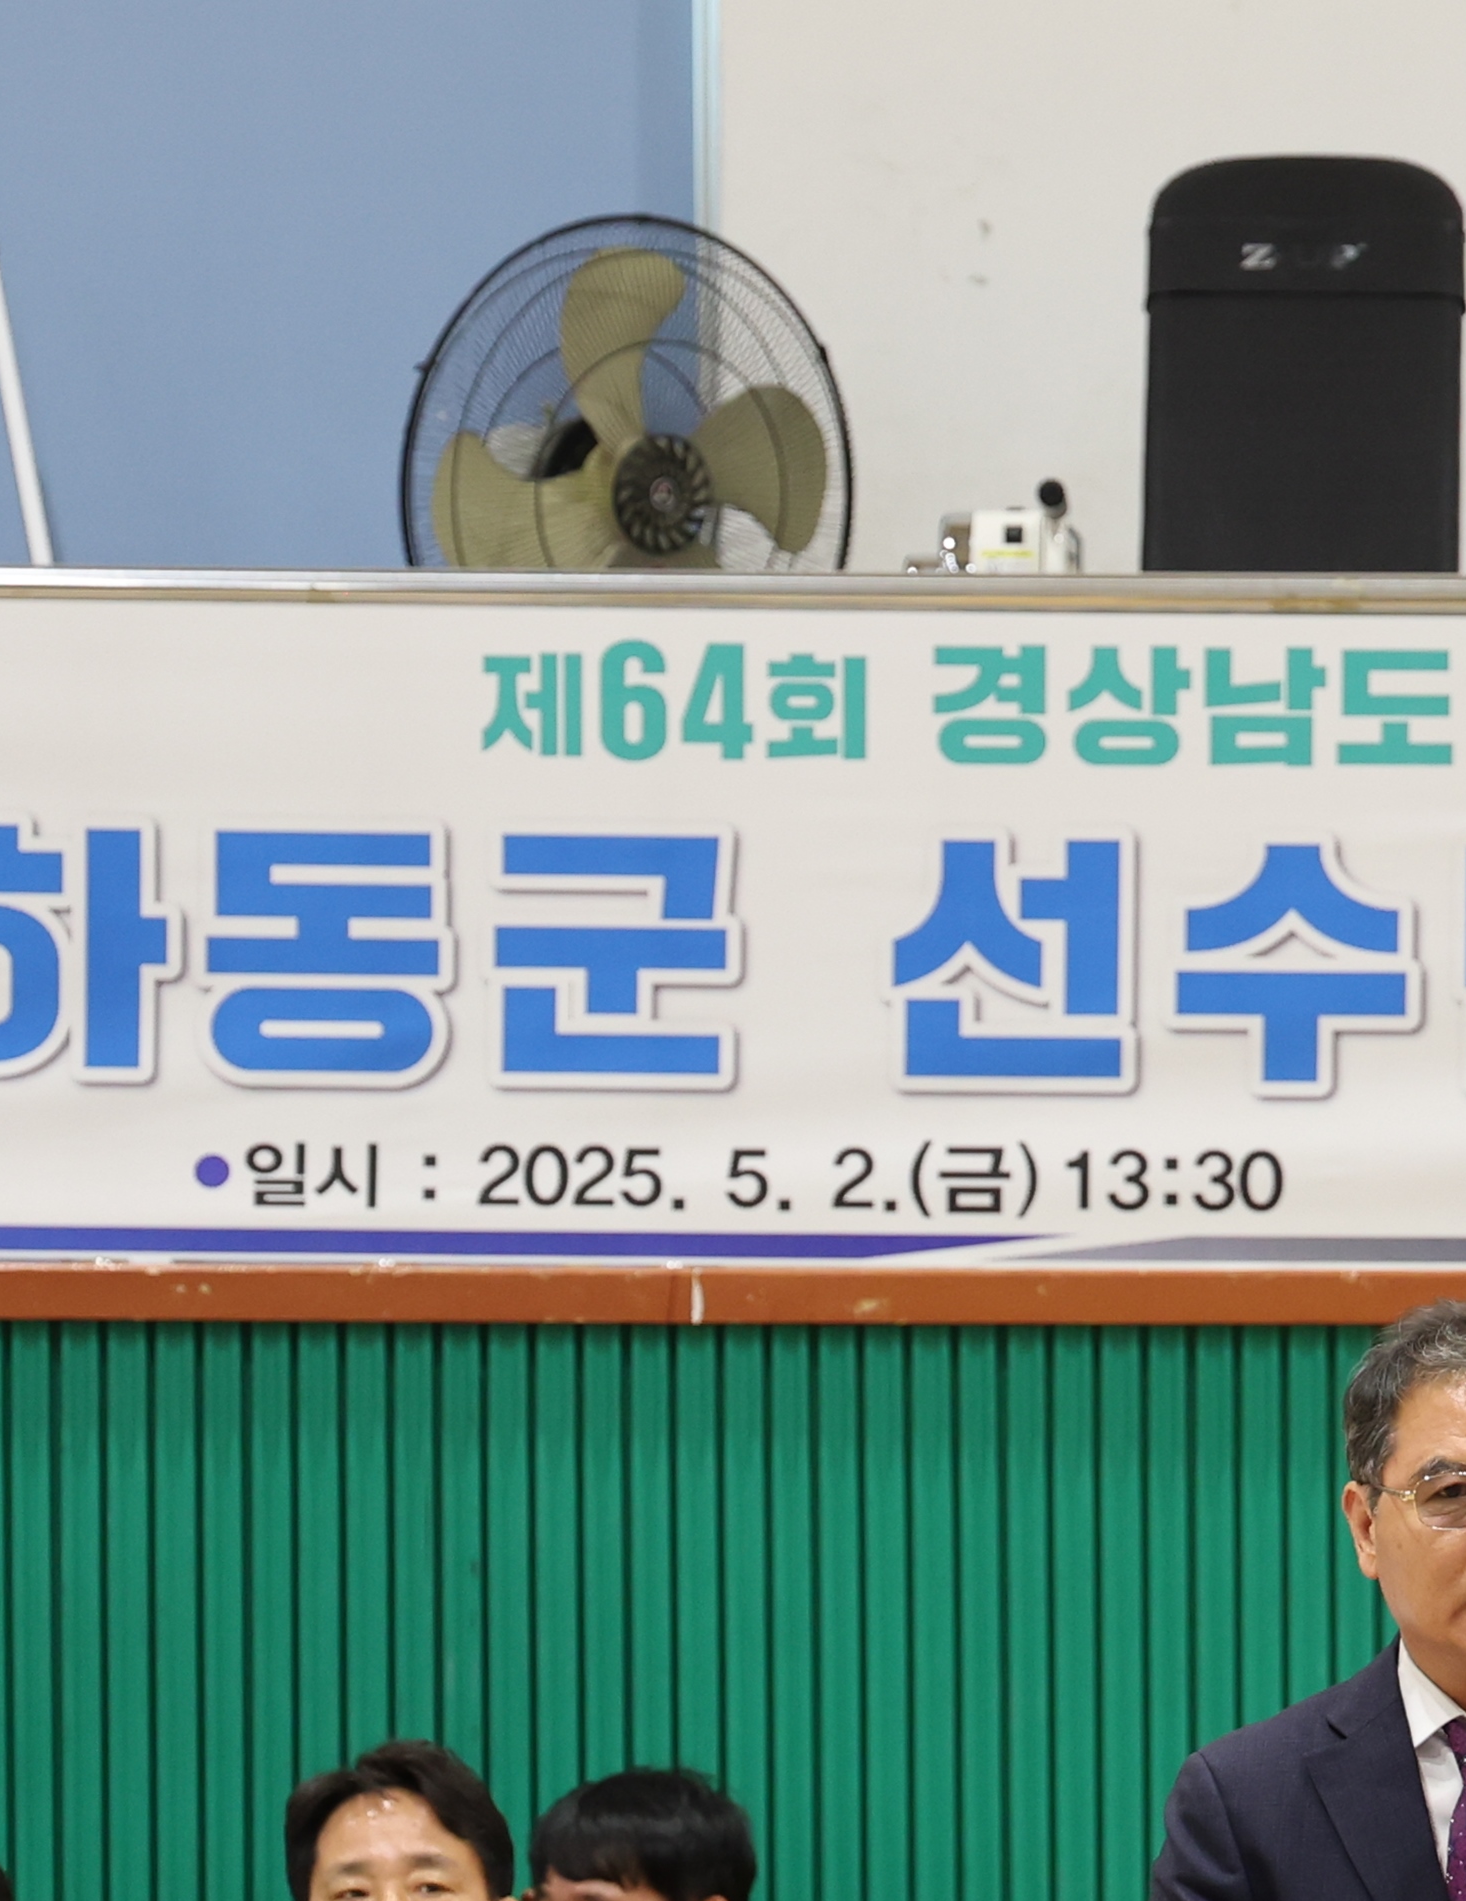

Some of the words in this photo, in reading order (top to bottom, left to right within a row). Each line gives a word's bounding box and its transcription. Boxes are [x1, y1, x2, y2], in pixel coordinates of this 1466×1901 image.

[483, 640, 867, 762] 제64회
[246, 1142, 378, 1208] 일시
[478, 1144, 684, 1211] 2025.
[727, 1149, 791, 1211] 5.
[832, 1141, 1037, 1218] 2.(금)
[1067, 1149, 1284, 1212] 13:30
